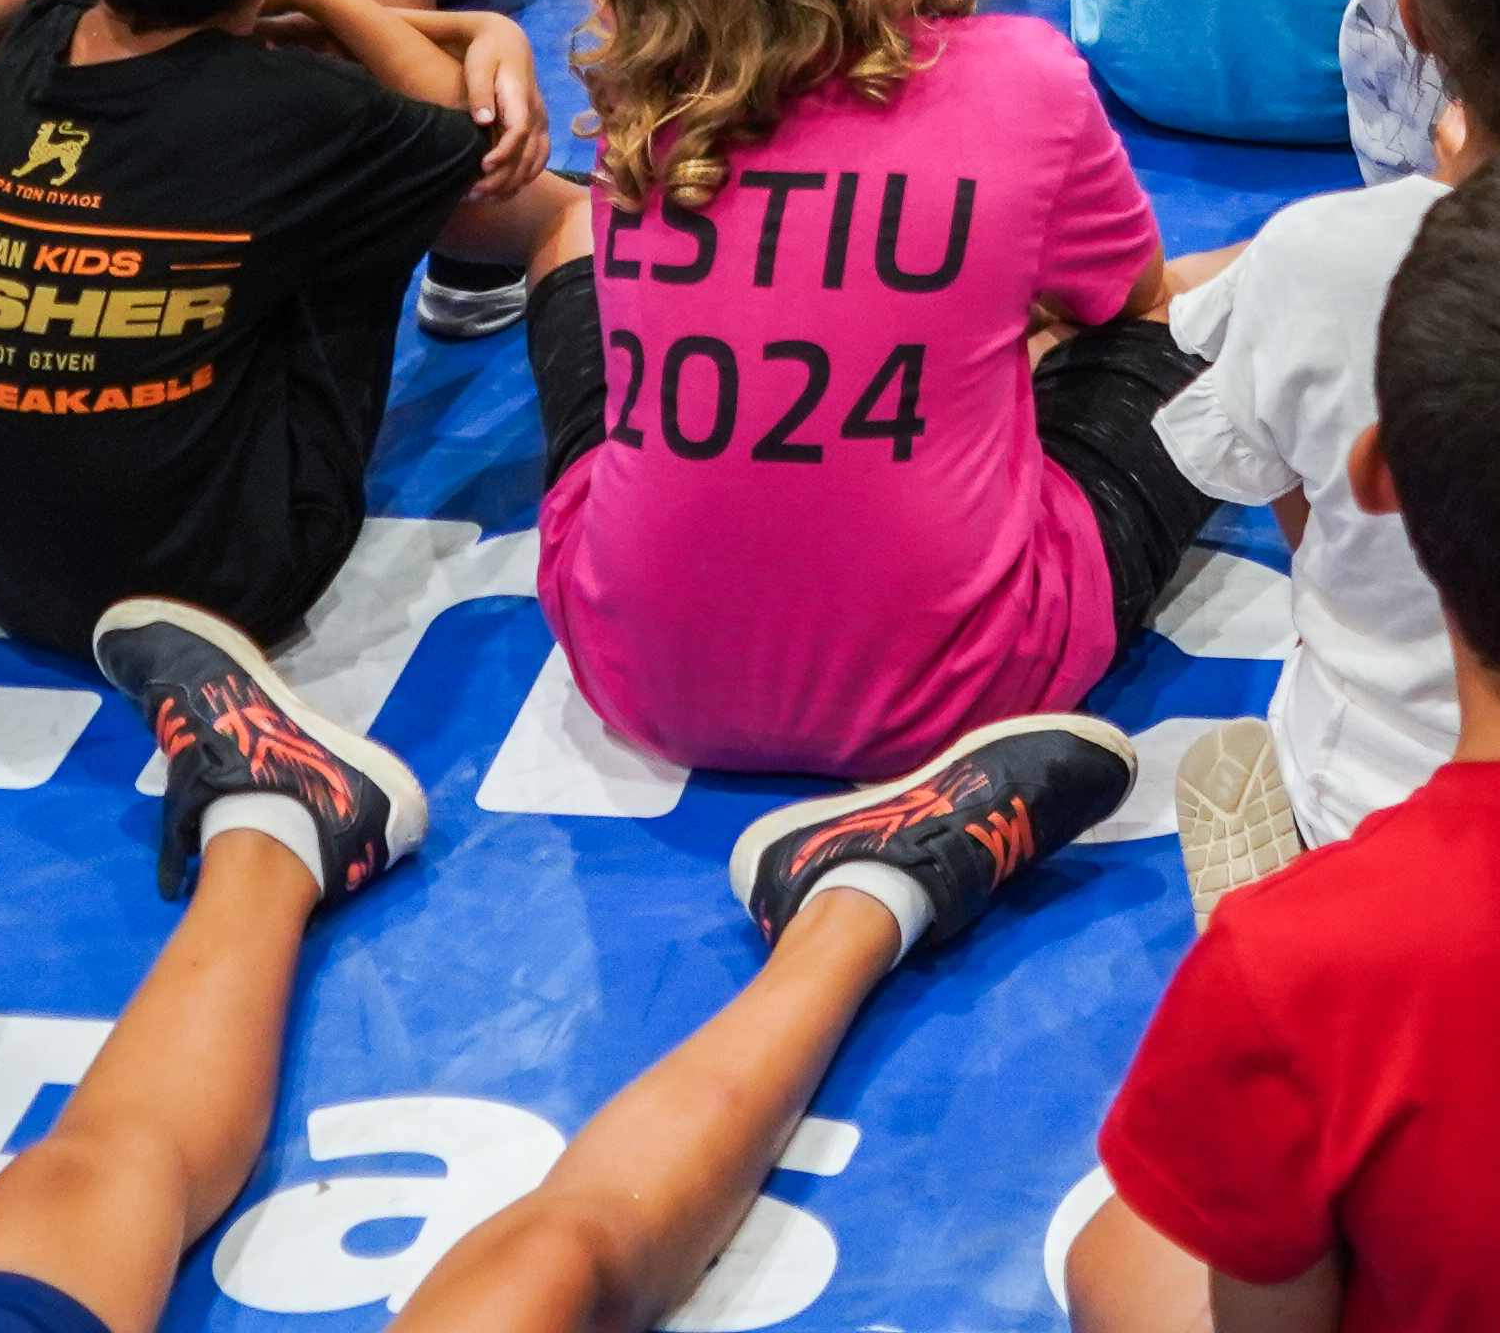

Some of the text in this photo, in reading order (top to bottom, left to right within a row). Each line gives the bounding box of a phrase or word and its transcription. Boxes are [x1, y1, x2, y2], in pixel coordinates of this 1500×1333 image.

[33, 245, 144, 278] KIDS
[603, 170, 978, 294] ESTIU
[28, 351, 97, 373] GIVEN
[608, 334, 927, 464] 2024
